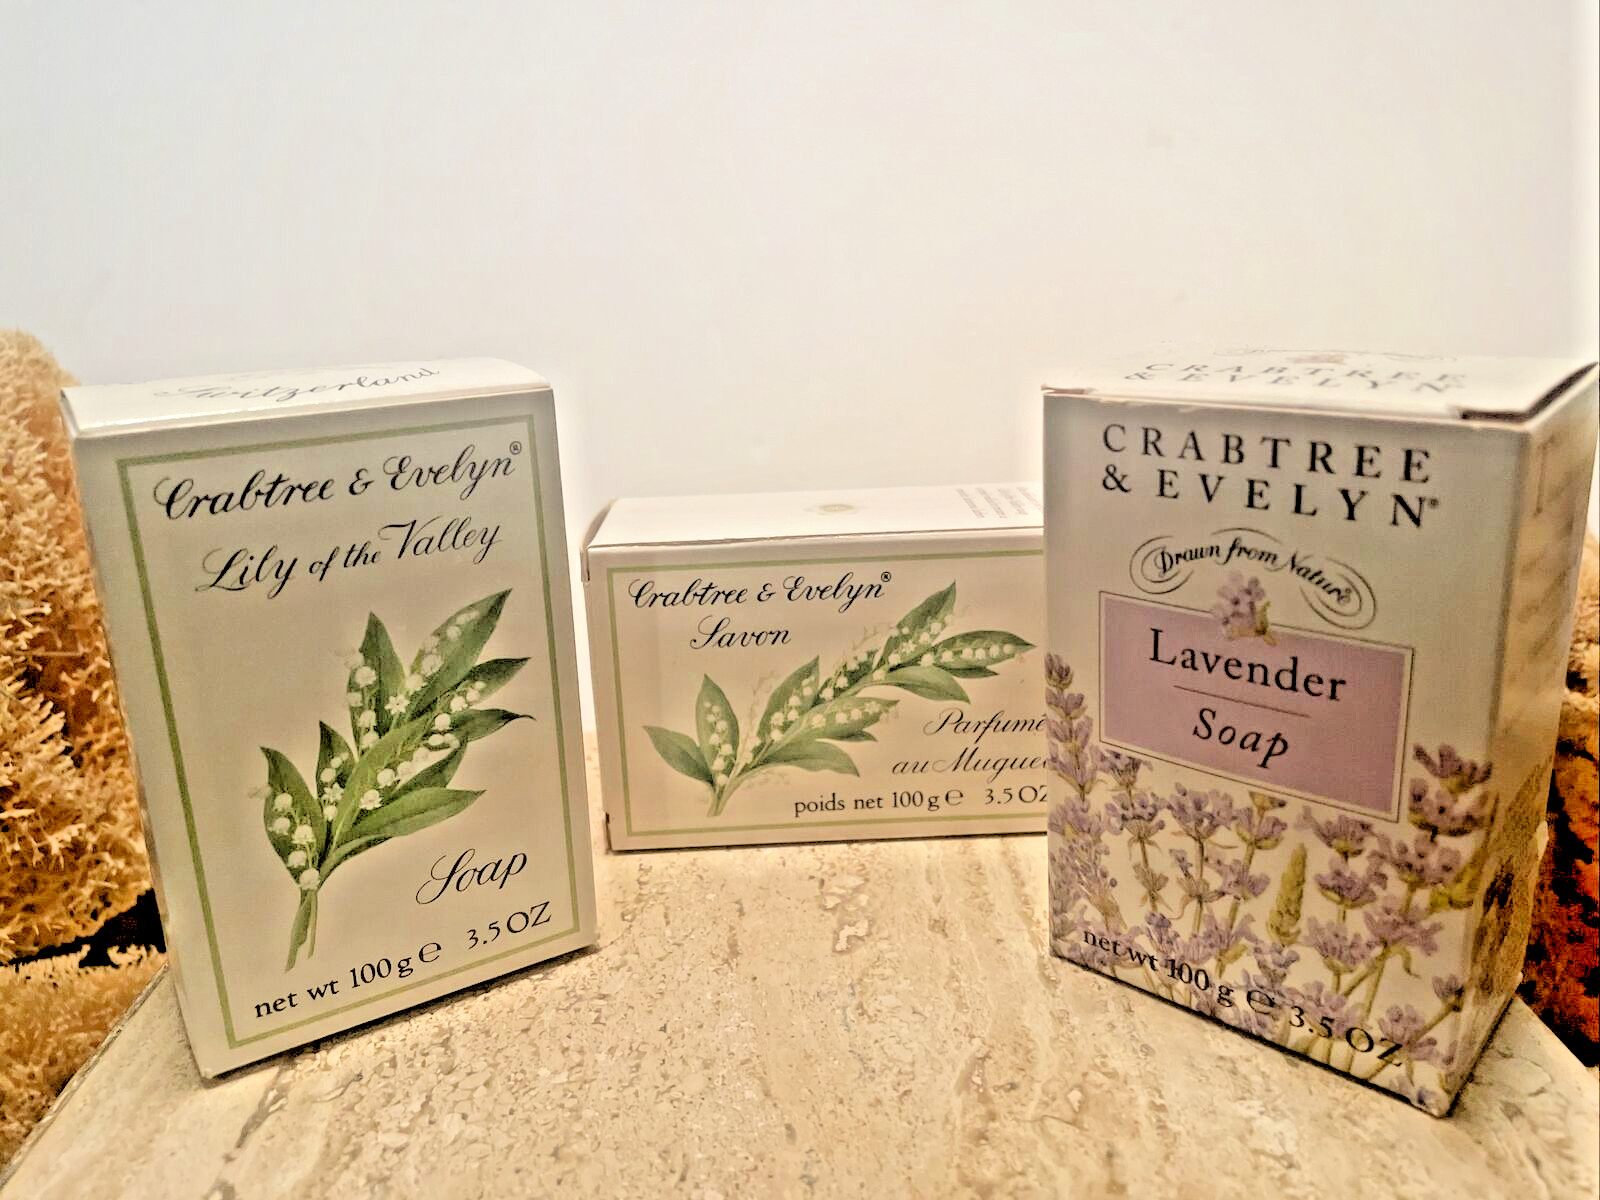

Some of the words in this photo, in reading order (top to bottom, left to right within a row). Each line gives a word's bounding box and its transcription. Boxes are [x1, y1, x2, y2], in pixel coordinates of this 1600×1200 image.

[1103, 424, 1431, 484] CRABTREE
[153, 469, 335, 521] Crabtree
[347, 467, 376, 496] &
[1101, 464, 1132, 494] &
[194, 544, 299, 599] Lily
[308, 547, 340, 582] of
[343, 541, 380, 568] the
[378, 515, 503, 565] Valley
[1153, 544, 1220, 578] Drawn
[1214, 537, 1278, 566] from
[628, 579, 748, 609] Crabtree
[756, 580, 776, 602] &
[689, 615, 792, 650] Savon
[1149, 627, 1347, 701] Lavender
[923, 707, 1048, 743] Parfumé
[1192, 707, 1289, 769] Soap
[891, 758, 931, 775] au
[793, 791, 846, 818] poids
[853, 796, 885, 810] net
[415, 848, 528, 905] Soap
[1082, 927, 1120, 956] net
[1124, 947, 1160, 972] wt
[254, 992, 298, 1018] net
[306, 979, 340, 1001] wt
